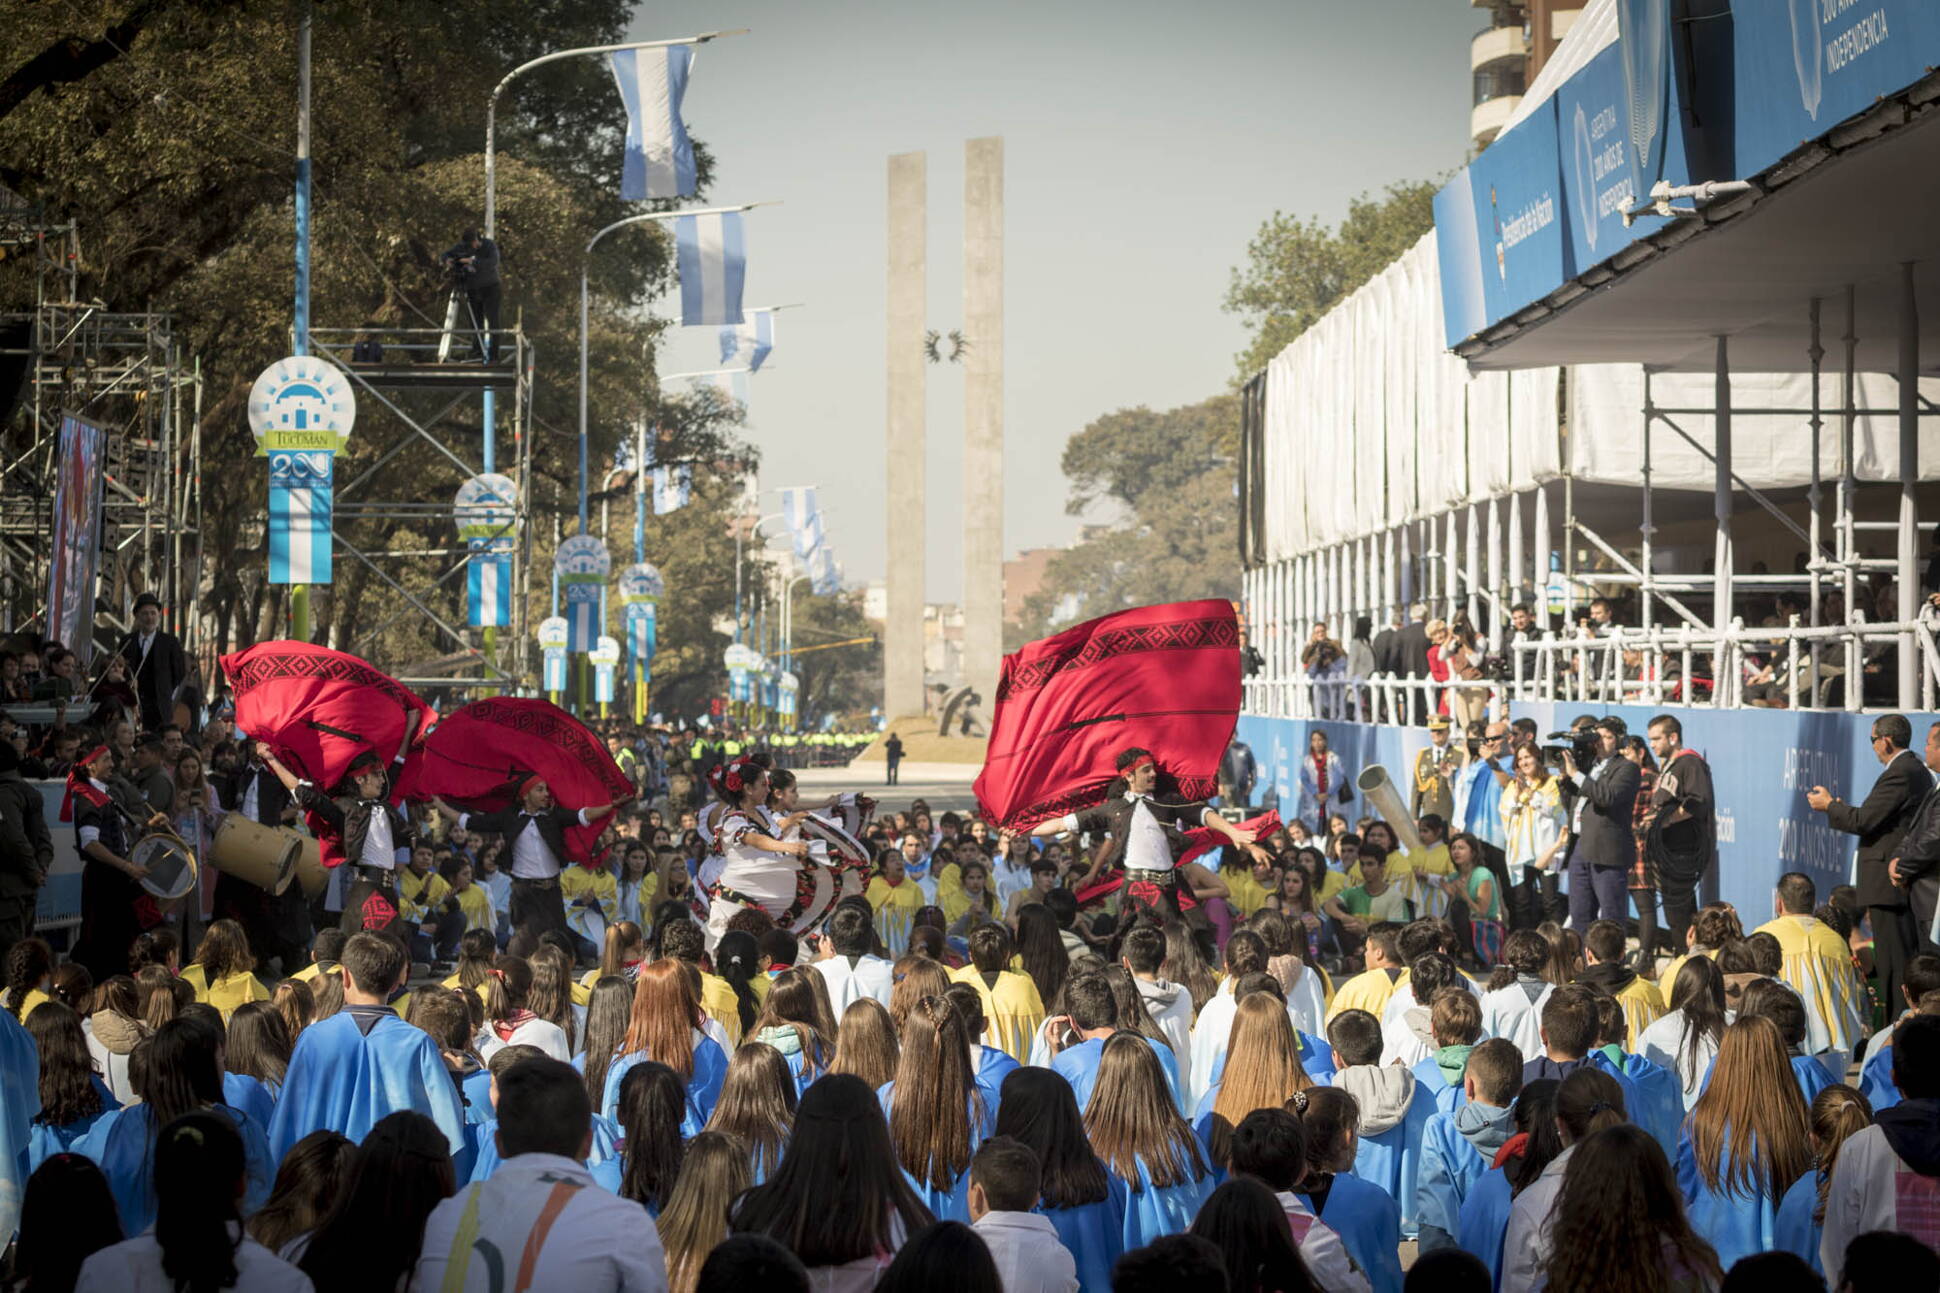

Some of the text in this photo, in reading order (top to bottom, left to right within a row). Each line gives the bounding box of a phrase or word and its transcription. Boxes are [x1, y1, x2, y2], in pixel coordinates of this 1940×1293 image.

[1826, 8, 1889, 74] INDEPENDENCIA
[1783, 747, 1839, 797] ARGENTINA
[1779, 812, 1842, 873] 200 AÑOS DE
